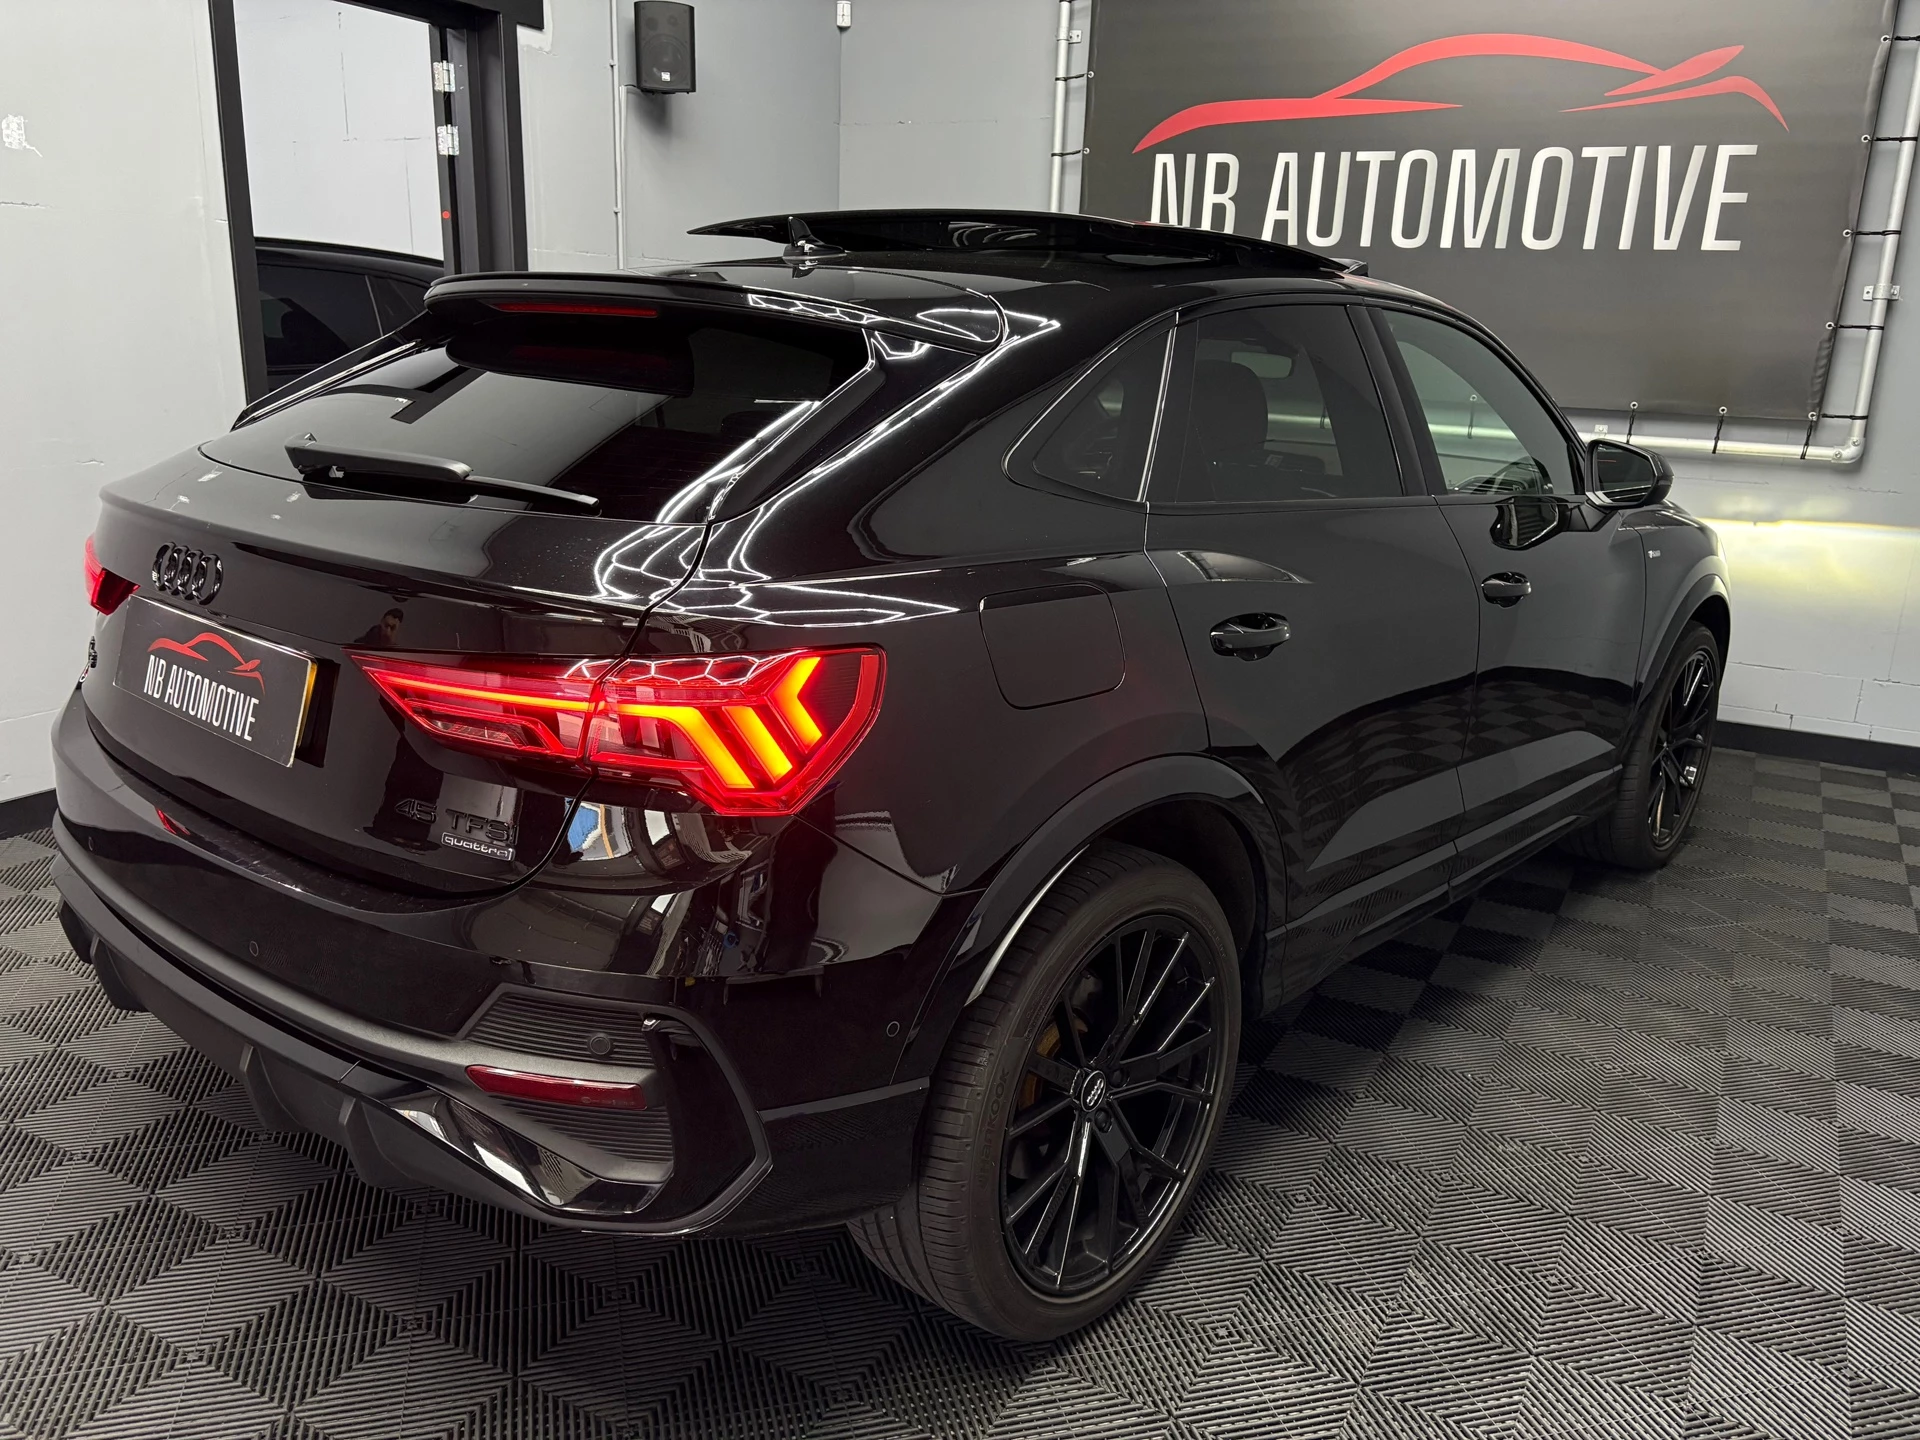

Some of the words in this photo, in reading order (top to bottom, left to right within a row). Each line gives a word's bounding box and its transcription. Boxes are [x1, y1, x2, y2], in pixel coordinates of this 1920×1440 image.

[1150, 152, 1240, 235] NB
[1260, 144, 1758, 251] AUTOMOTIVE
[143, 654, 166, 699] NB
[164, 664, 260, 742] AUTOMOTIVE
[395, 798, 438, 825] 45
[445, 808, 519, 845] TFSI
[444, 836, 508, 858] quattro
